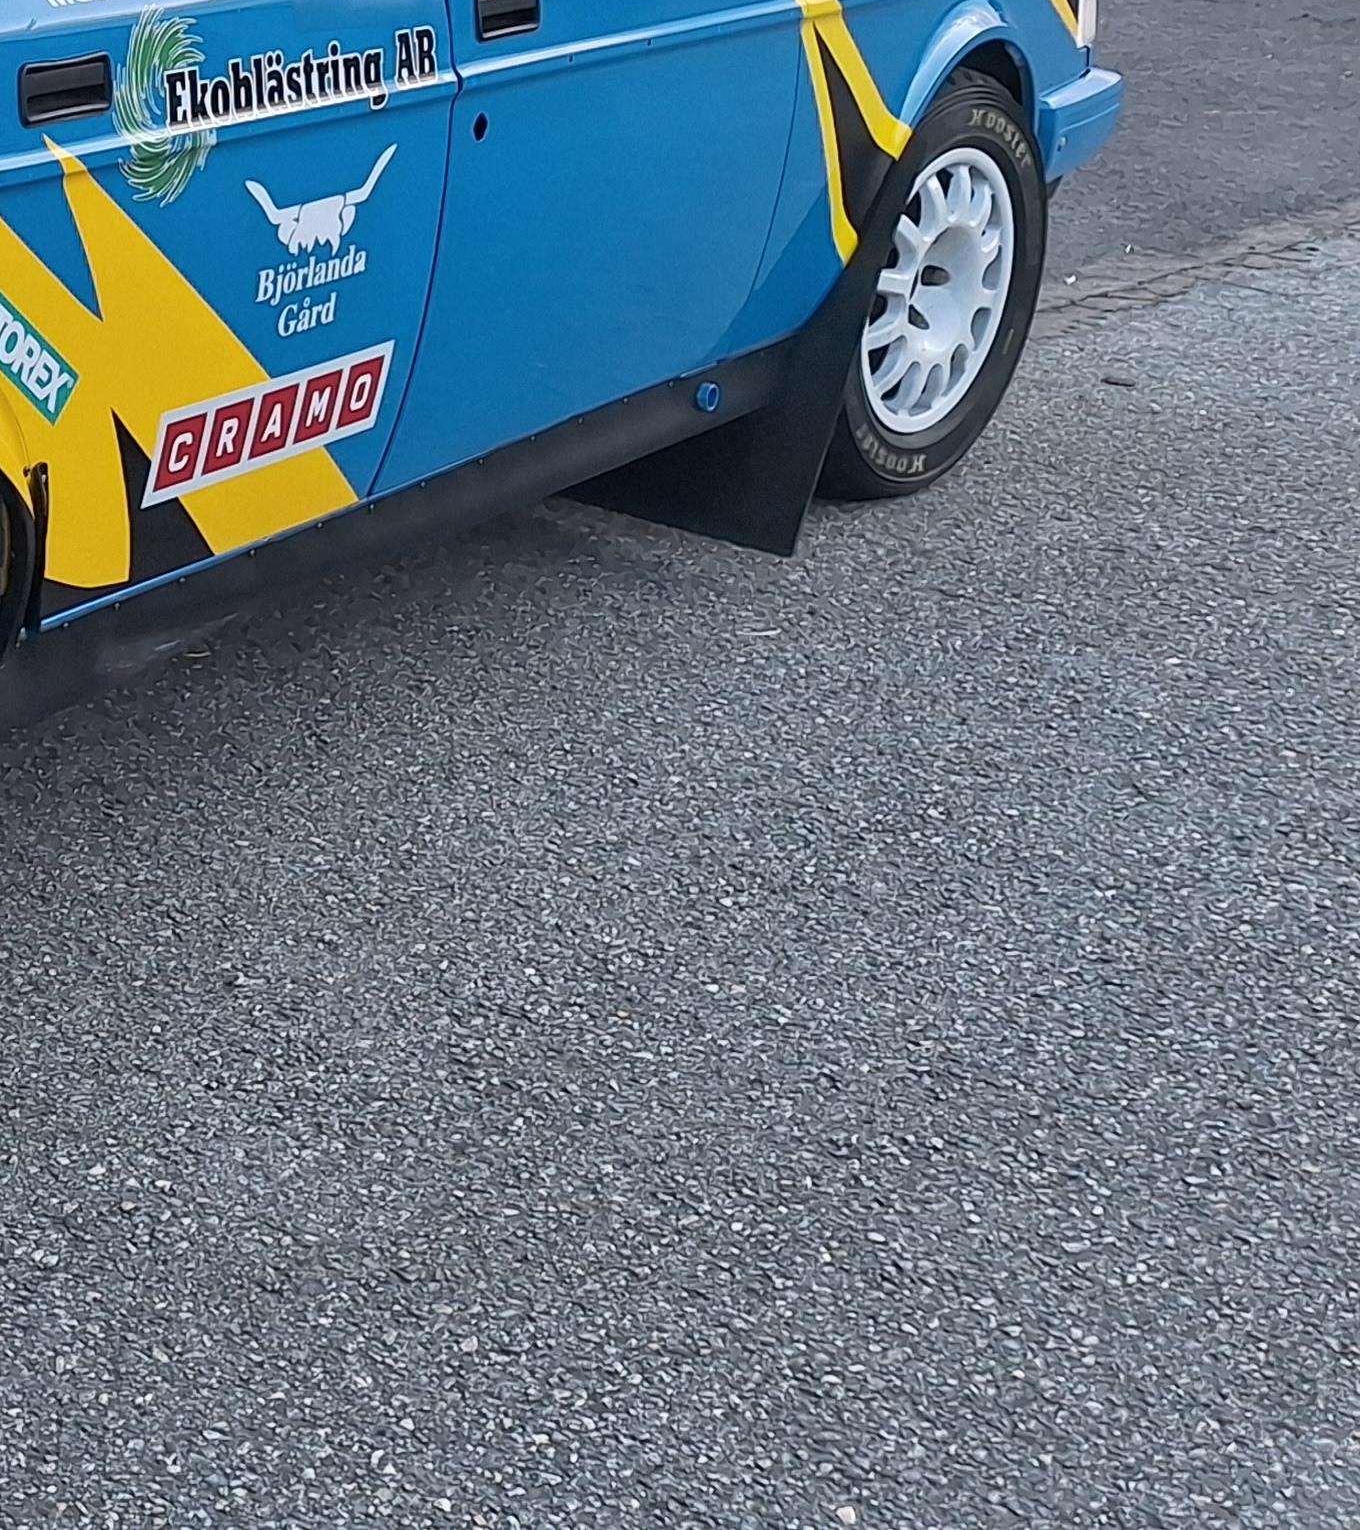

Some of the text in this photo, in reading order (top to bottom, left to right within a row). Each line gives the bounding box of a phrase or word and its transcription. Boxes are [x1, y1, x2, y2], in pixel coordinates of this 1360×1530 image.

[165, 25, 439, 135] Ekoblästring AB
[255, 245, 367, 306] Björlanda
[278, 292, 337, 337] Gård
[166, 371, 373, 474] CRAMO
